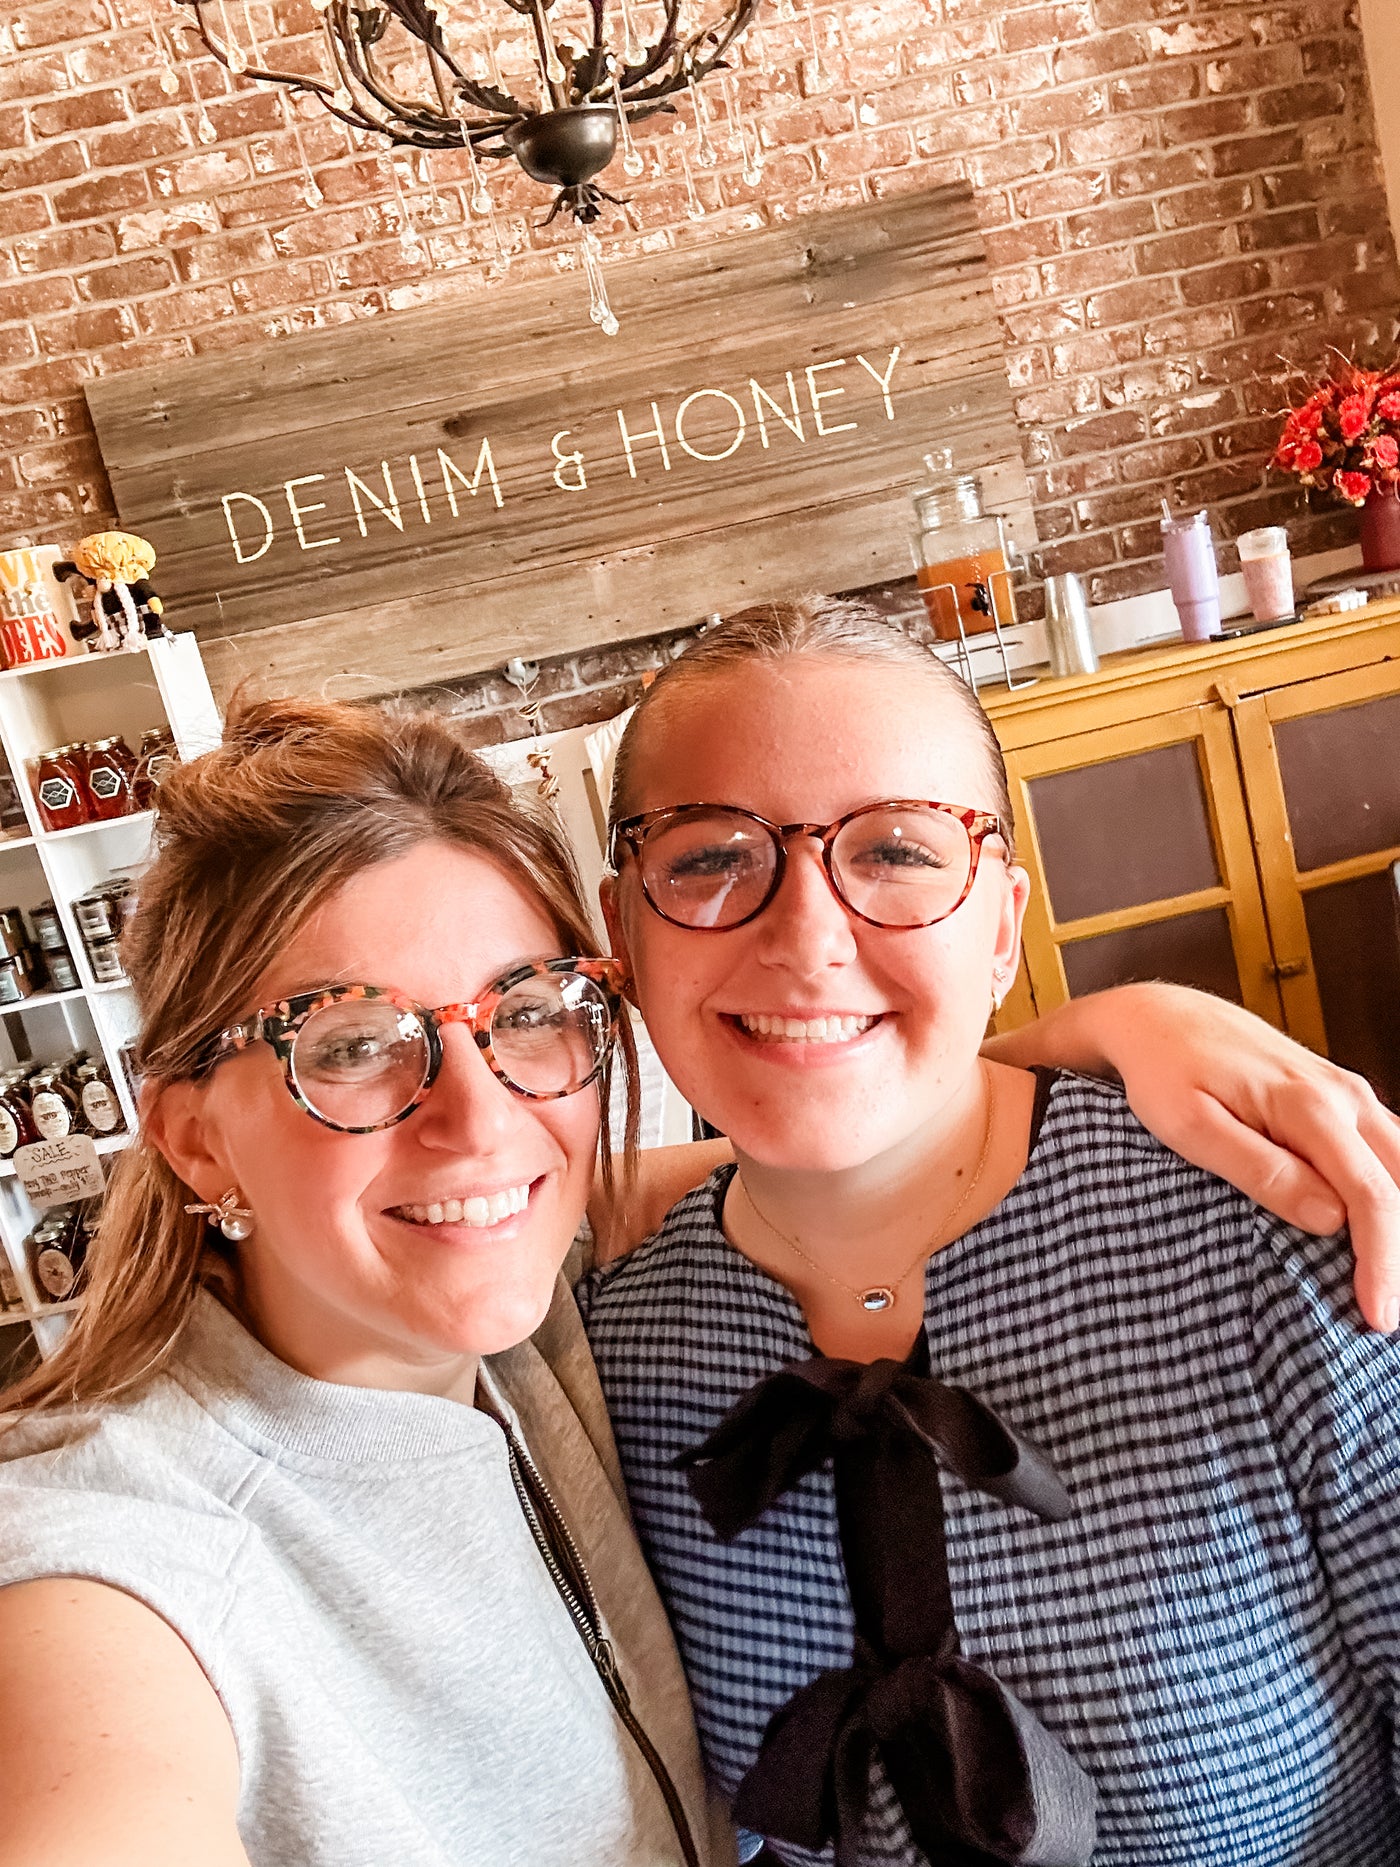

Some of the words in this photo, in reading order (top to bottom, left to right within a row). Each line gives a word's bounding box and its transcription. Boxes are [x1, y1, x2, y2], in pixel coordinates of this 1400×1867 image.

[222, 438, 504, 564] DENIM
[552, 430, 587, 491] &
[617, 346, 901, 478] HONEY
[31, 1142, 71, 1163] SALE
